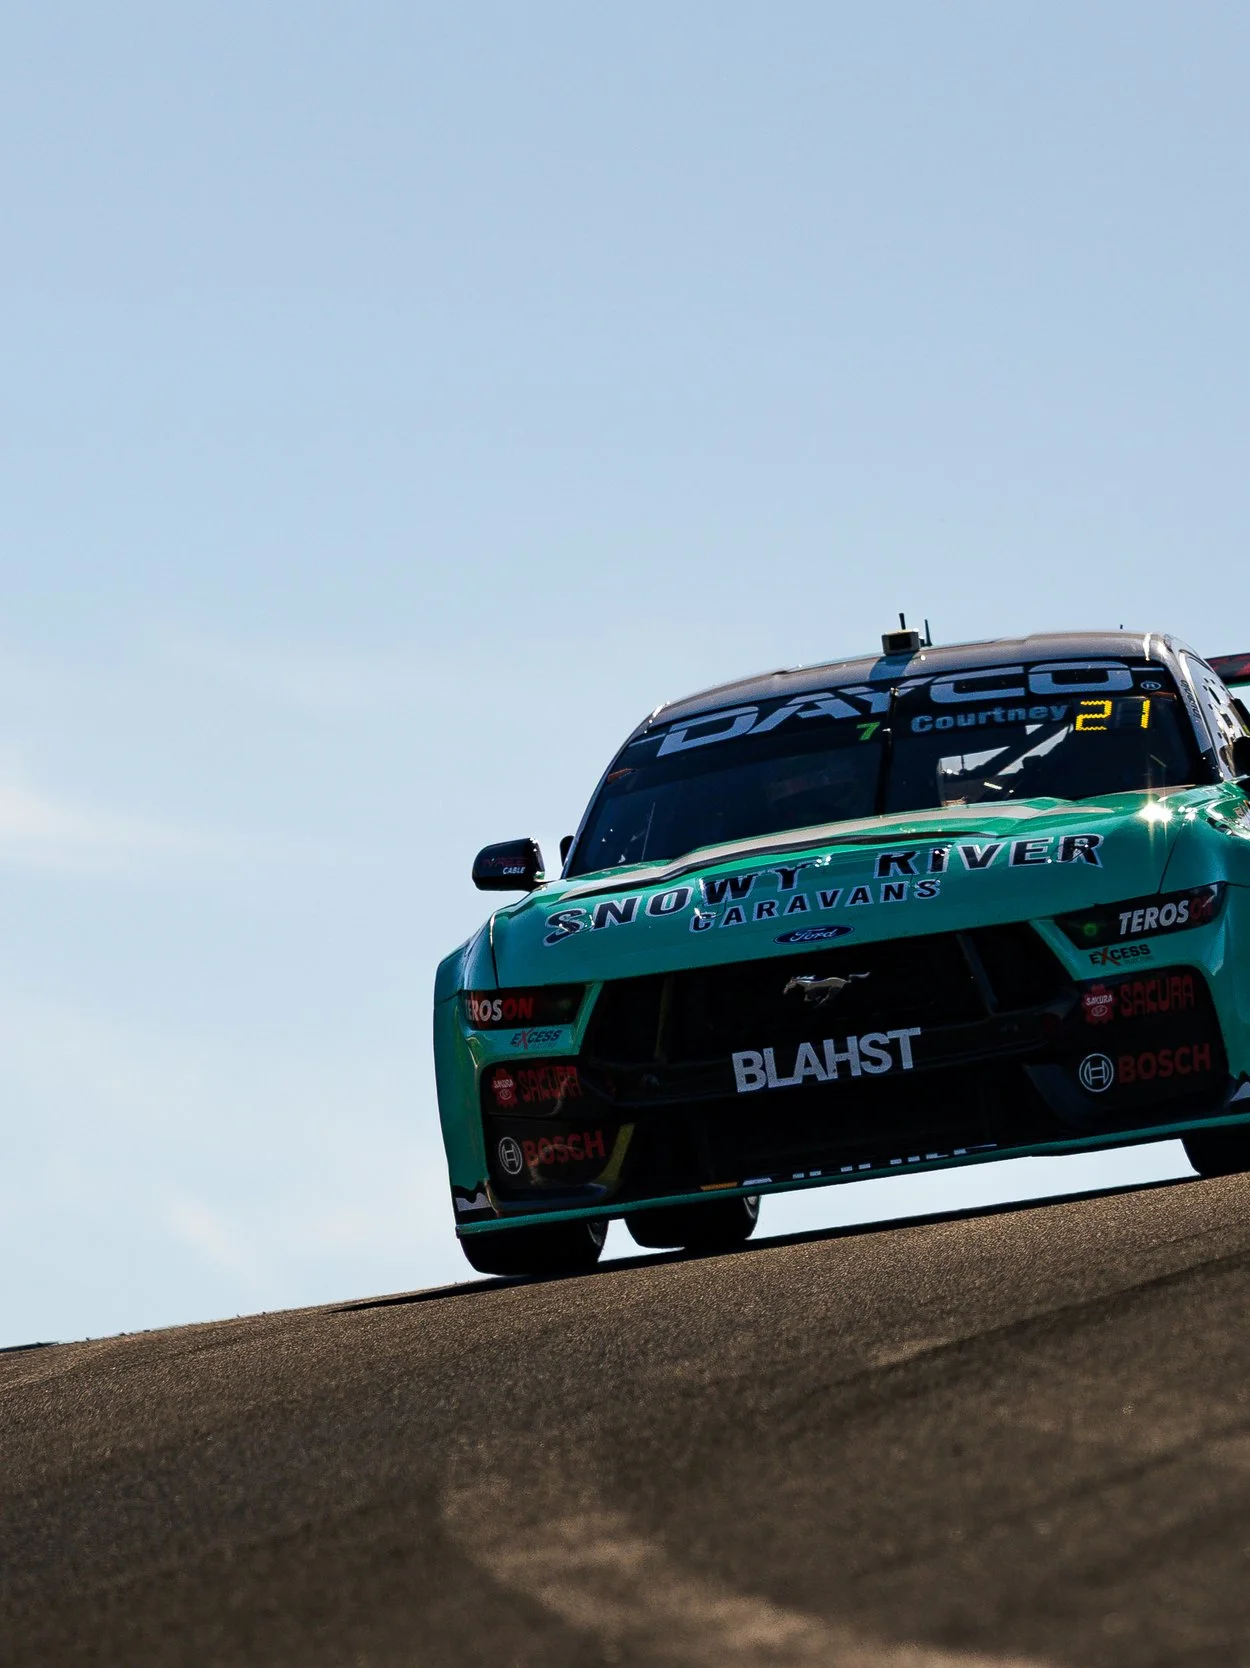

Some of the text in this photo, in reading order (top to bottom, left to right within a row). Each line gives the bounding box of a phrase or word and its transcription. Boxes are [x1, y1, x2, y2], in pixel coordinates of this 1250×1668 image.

[656, 660, 1134, 758] DAYCO
[911, 703, 1069, 733] Courtney
[1075, 699, 1151, 731] 21
[856, 721, 880, 741] 7
[502, 866, 527, 875] CABLE
[543, 833, 1105, 946] SNOWY RIVER
[689, 879, 941, 933] CARAVANS
[1119, 974, 1196, 1018] SAKURA
[731, 1027, 922, 1093] BLAHST
[1118, 1042, 1212, 1084] BOSCH
[515, 1065, 584, 1101] SAKURA
[522, 1129, 607, 1167] BOSCH
